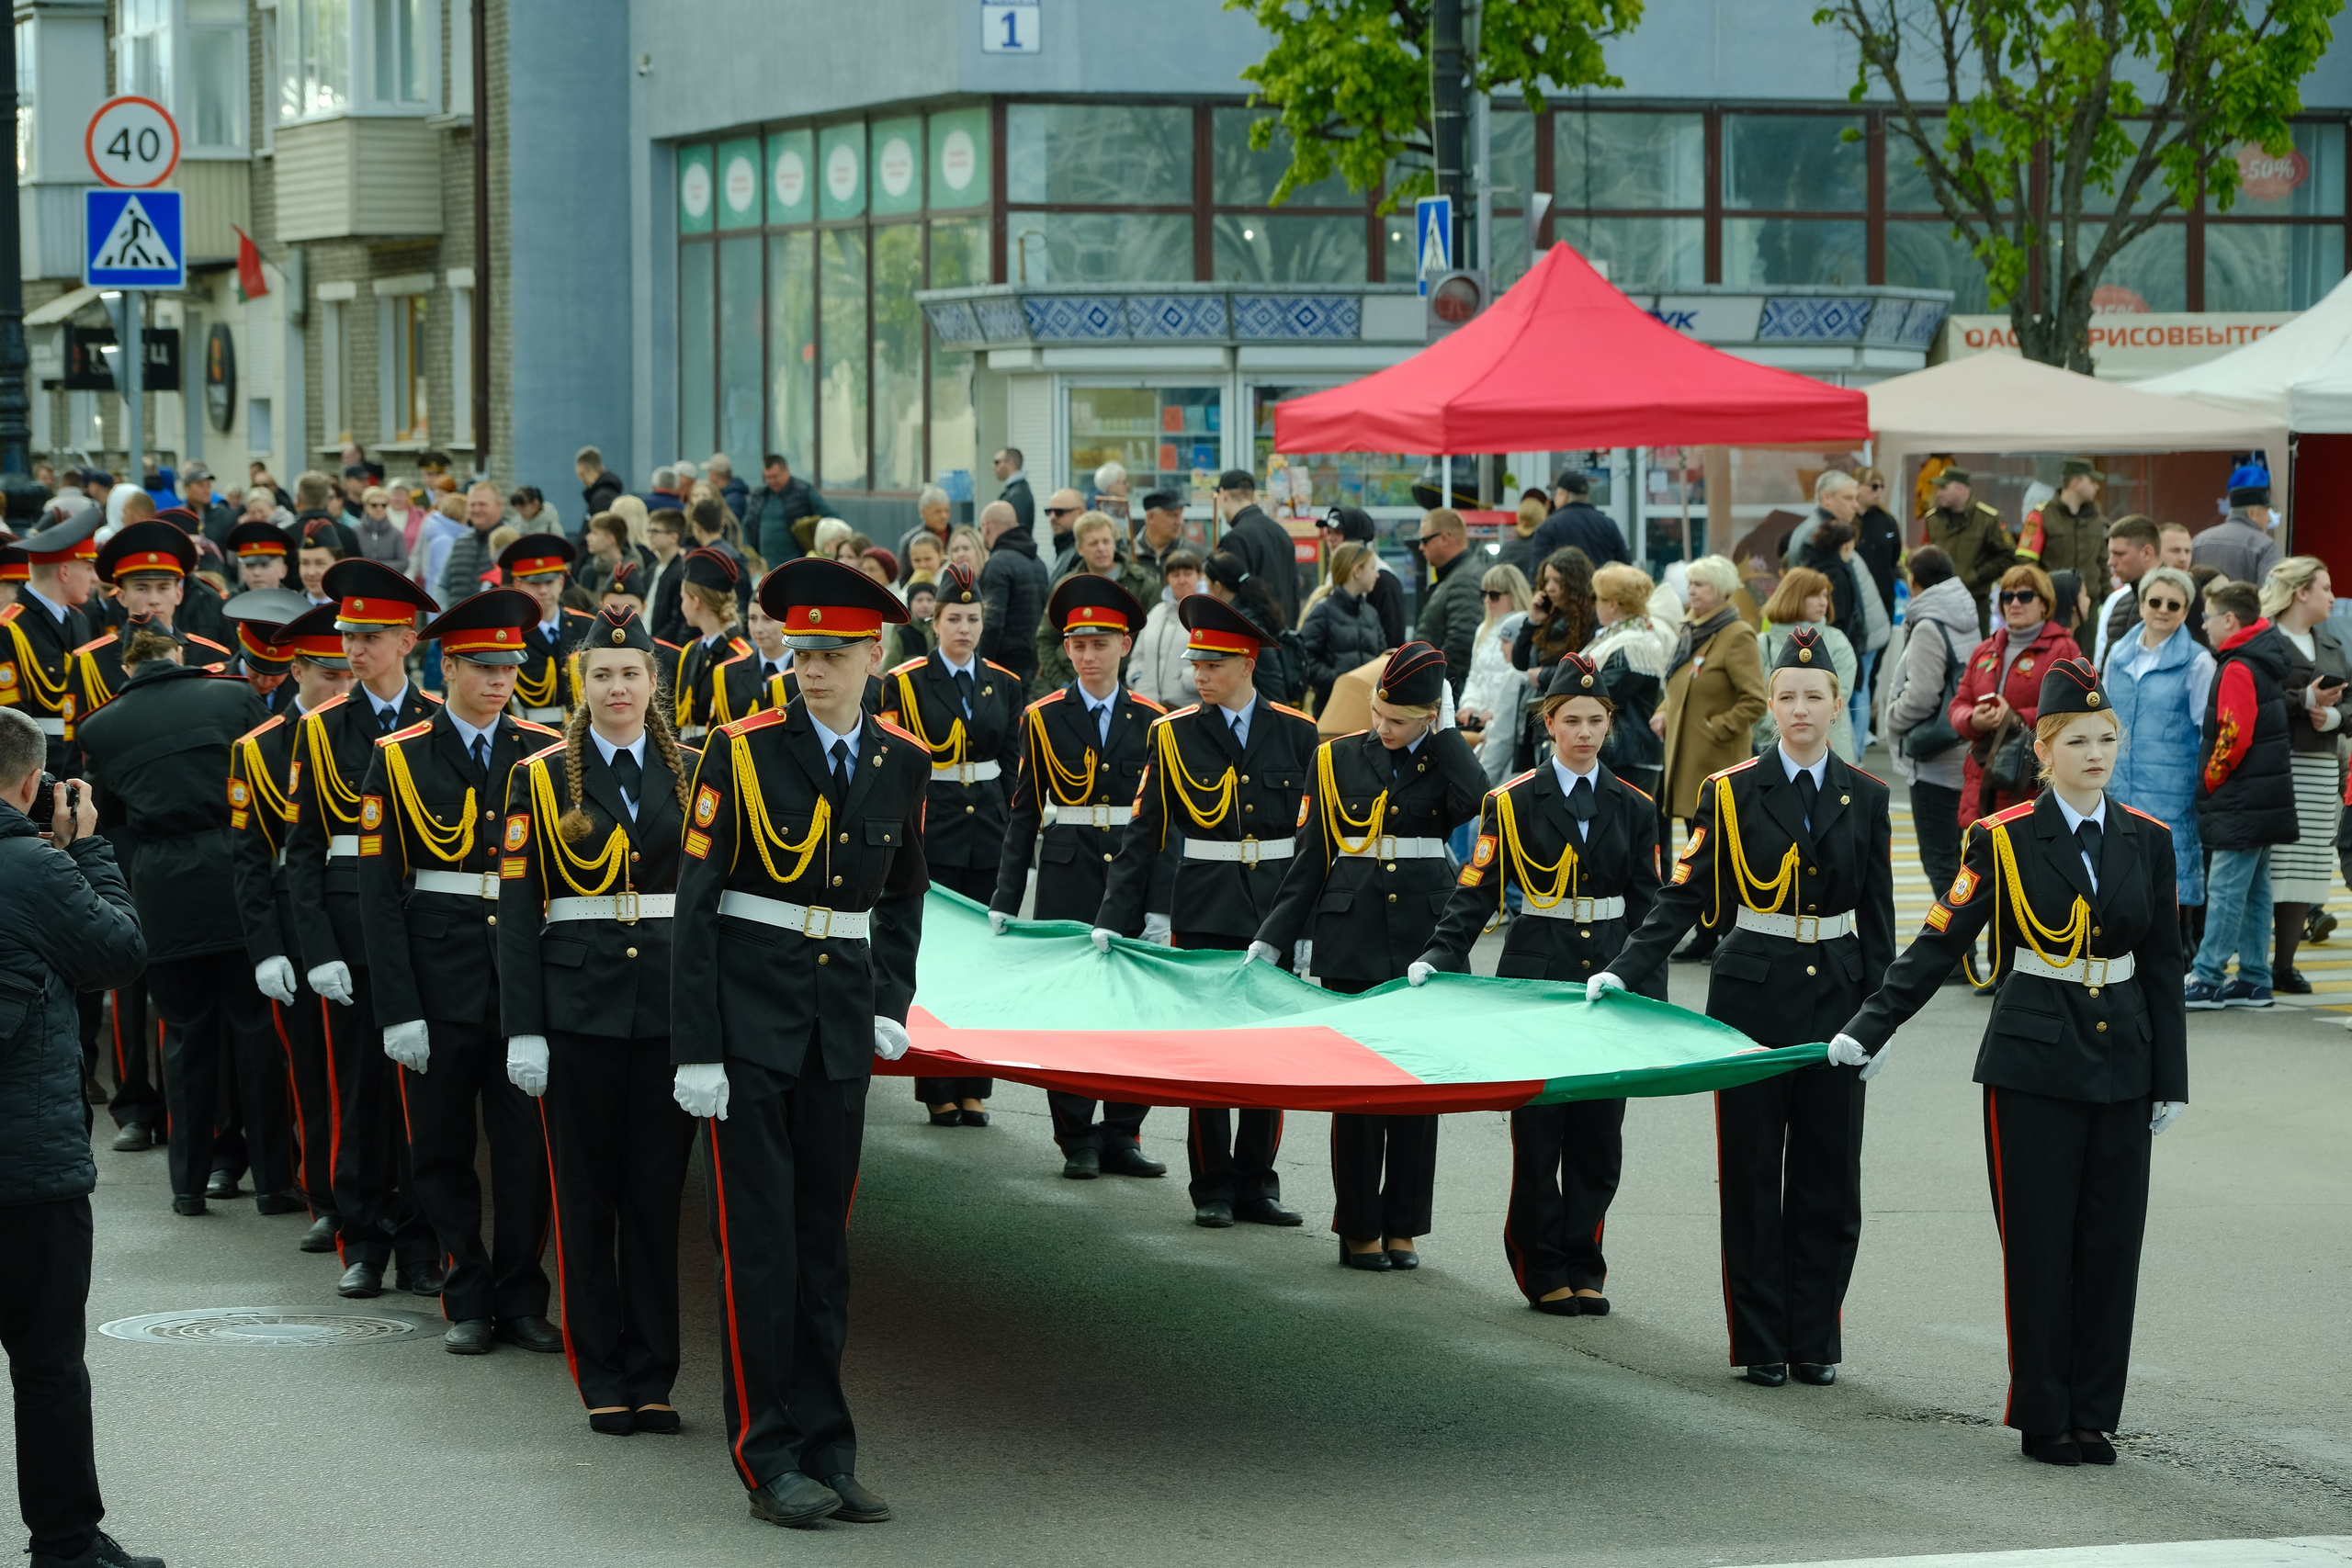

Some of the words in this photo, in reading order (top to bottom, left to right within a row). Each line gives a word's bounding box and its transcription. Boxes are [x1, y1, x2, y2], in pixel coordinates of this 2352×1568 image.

[1001, 11, 1022, 47] 1
[107, 128, 160, 162] 40
[2242, 158, 2295, 179] -50%
